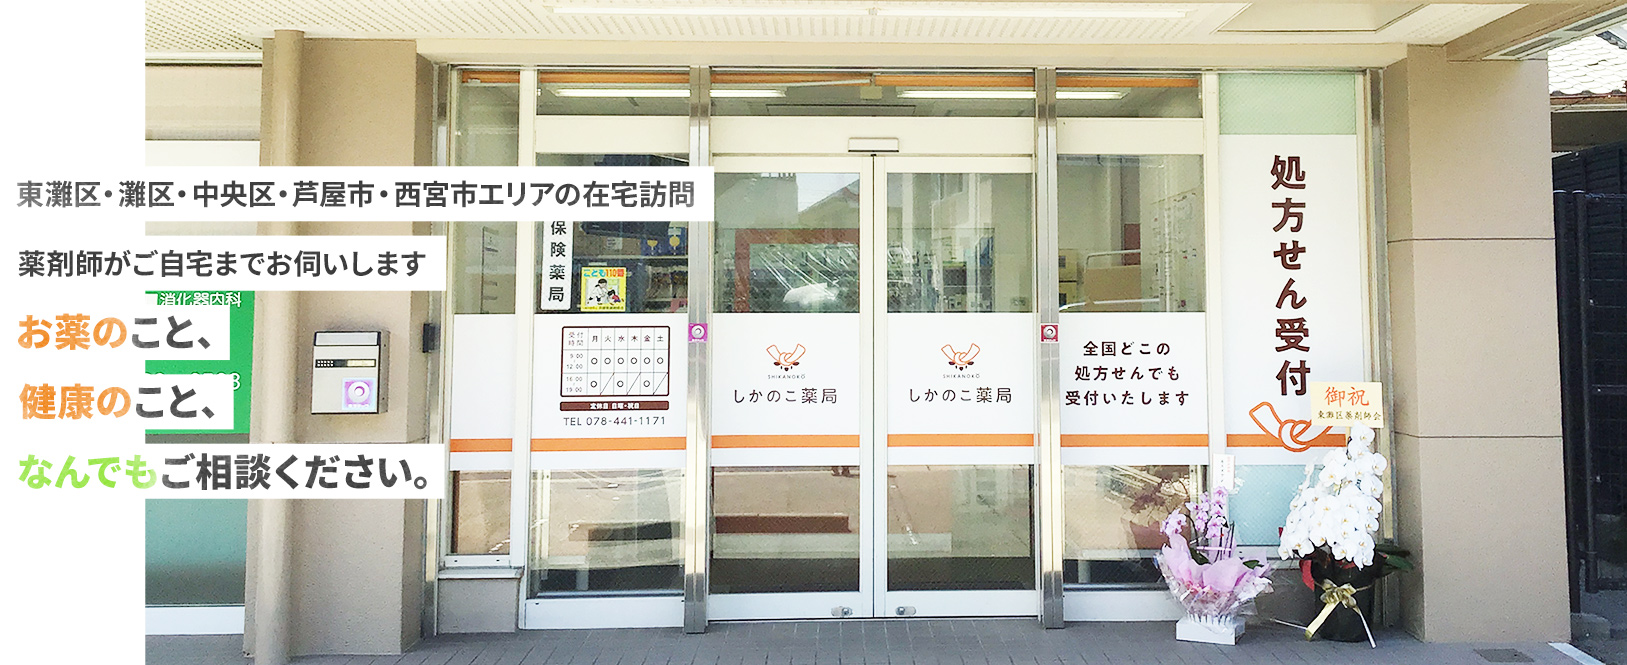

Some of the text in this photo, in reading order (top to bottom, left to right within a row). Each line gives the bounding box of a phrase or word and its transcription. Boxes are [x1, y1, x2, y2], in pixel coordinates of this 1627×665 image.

[548, 221, 567, 302] 保険薬局
[1270, 154, 1311, 396] 処方せん受付
[643, 334, 650, 342] 金
[1083, 341, 1170, 356] 全国どこの
[1074, 365, 1179, 381] 処方せんでも
[734, 387, 837, 404] しかのこ薬局
[909, 386, 1012, 404] しかのこ薬局
[1065, 390, 1189, 406] 受付いたします
[1325, 386, 1370, 408] 御祝
[563, 416, 665, 426] TEL 078-441-1171
